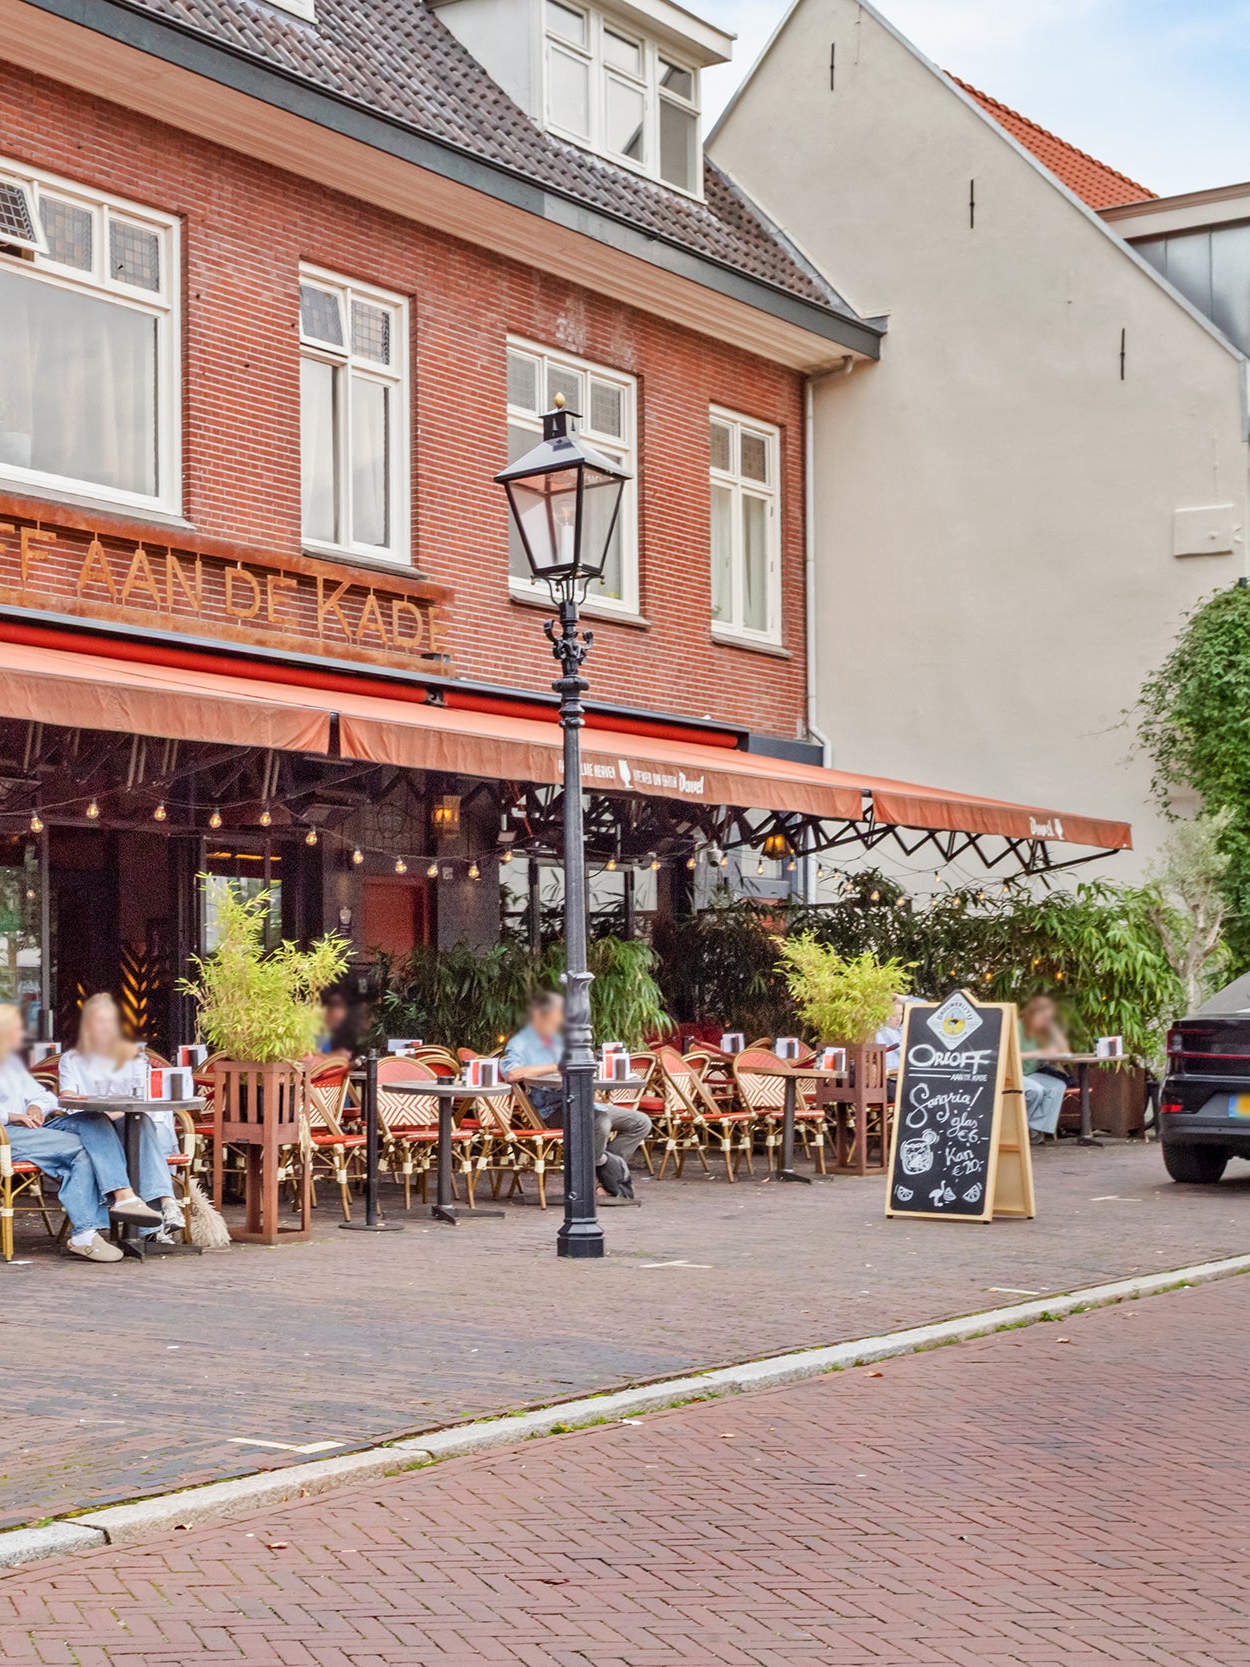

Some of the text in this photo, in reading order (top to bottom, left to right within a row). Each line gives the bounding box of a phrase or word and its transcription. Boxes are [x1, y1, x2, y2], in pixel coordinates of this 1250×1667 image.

[77, 541, 203, 612] AAN
[225, 566, 298, 625] DE
[317, 575, 449, 652] KADE
[678, 771, 705, 795] Duvel
[946, 1111, 978, 1138] glas
[944, 1146, 975, 1167] Kan
